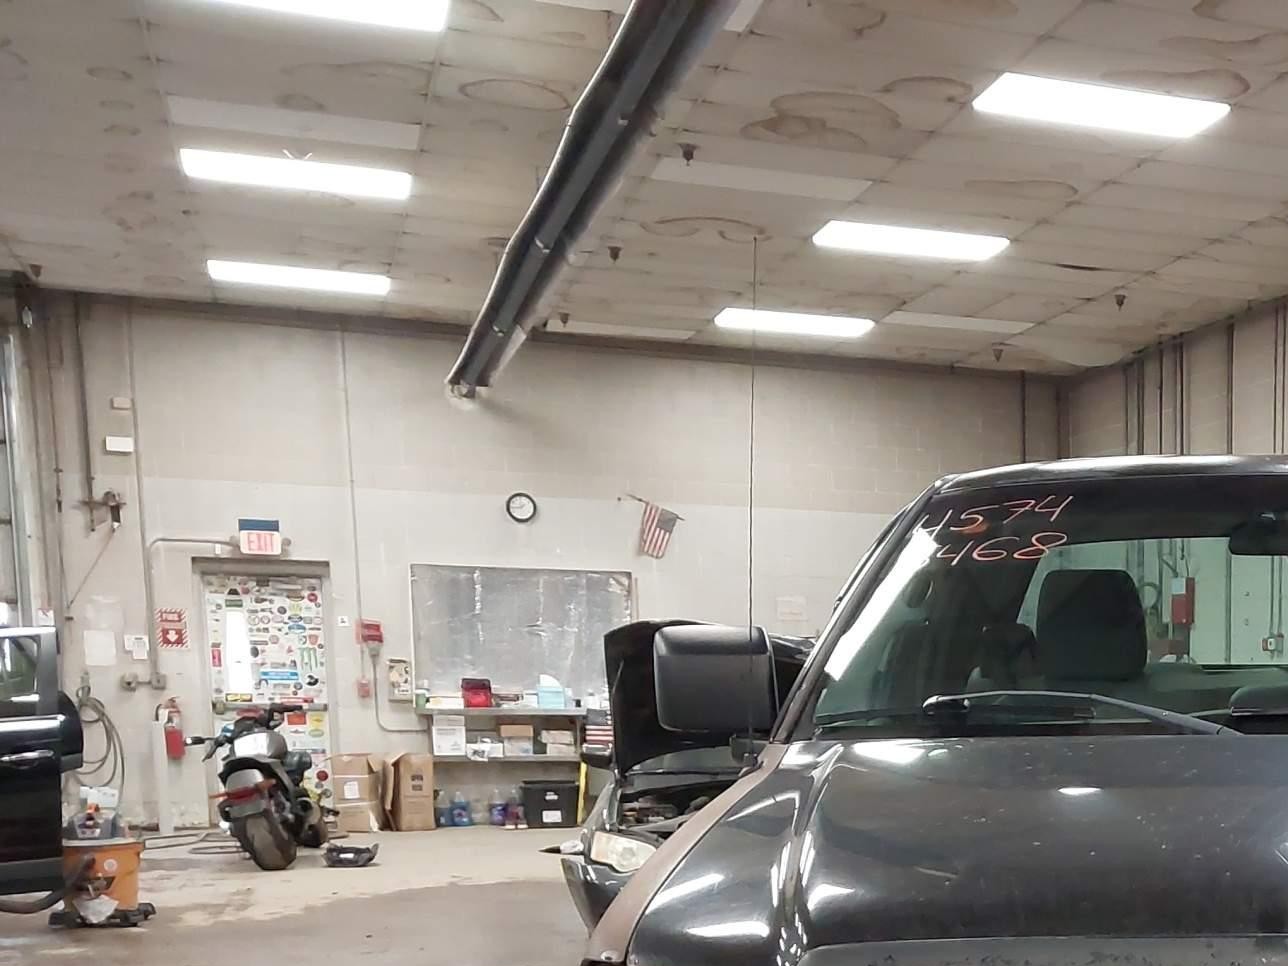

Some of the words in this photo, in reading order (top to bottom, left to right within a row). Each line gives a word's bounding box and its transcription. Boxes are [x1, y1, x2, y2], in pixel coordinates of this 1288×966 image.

[912, 495, 1074, 541] 4574
[247, 532, 275, 552] EXIT
[919, 531, 1068, 567] 468
